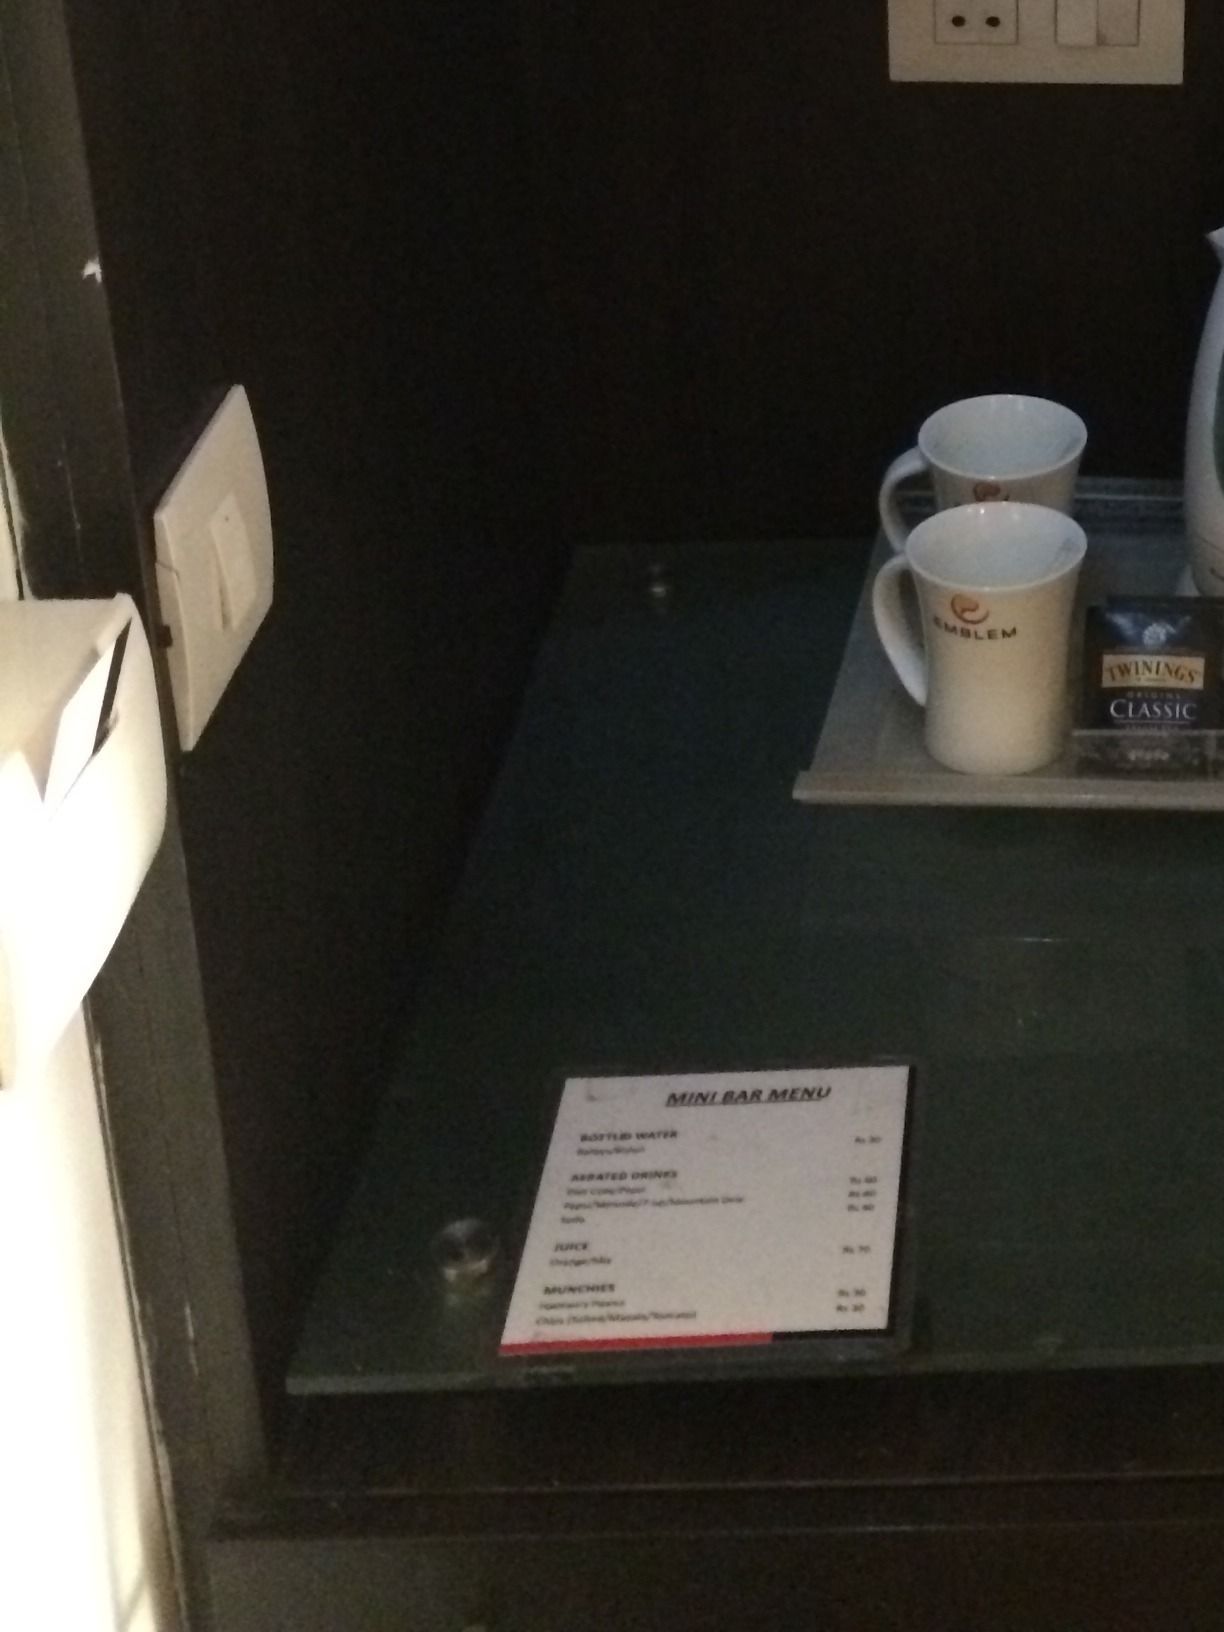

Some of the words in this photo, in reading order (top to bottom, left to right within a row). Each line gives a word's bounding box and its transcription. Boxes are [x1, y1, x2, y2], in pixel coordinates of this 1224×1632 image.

[933, 615, 1018, 641] EMBLEM
[1104, 659, 1200, 684] TWININGS
[1109, 698, 1198, 720] CLASSIC
[666, 1091, 719, 1106] MINI
[722, 1088, 763, 1104] BAR
[767, 1086, 832, 1102] MENU
[635, 1128, 679, 1140] WATER
[630, 1168, 679, 1179] DRINKS
[554, 1241, 590, 1253] JUICE
[543, 1283, 616, 1296] MUNCHIES
